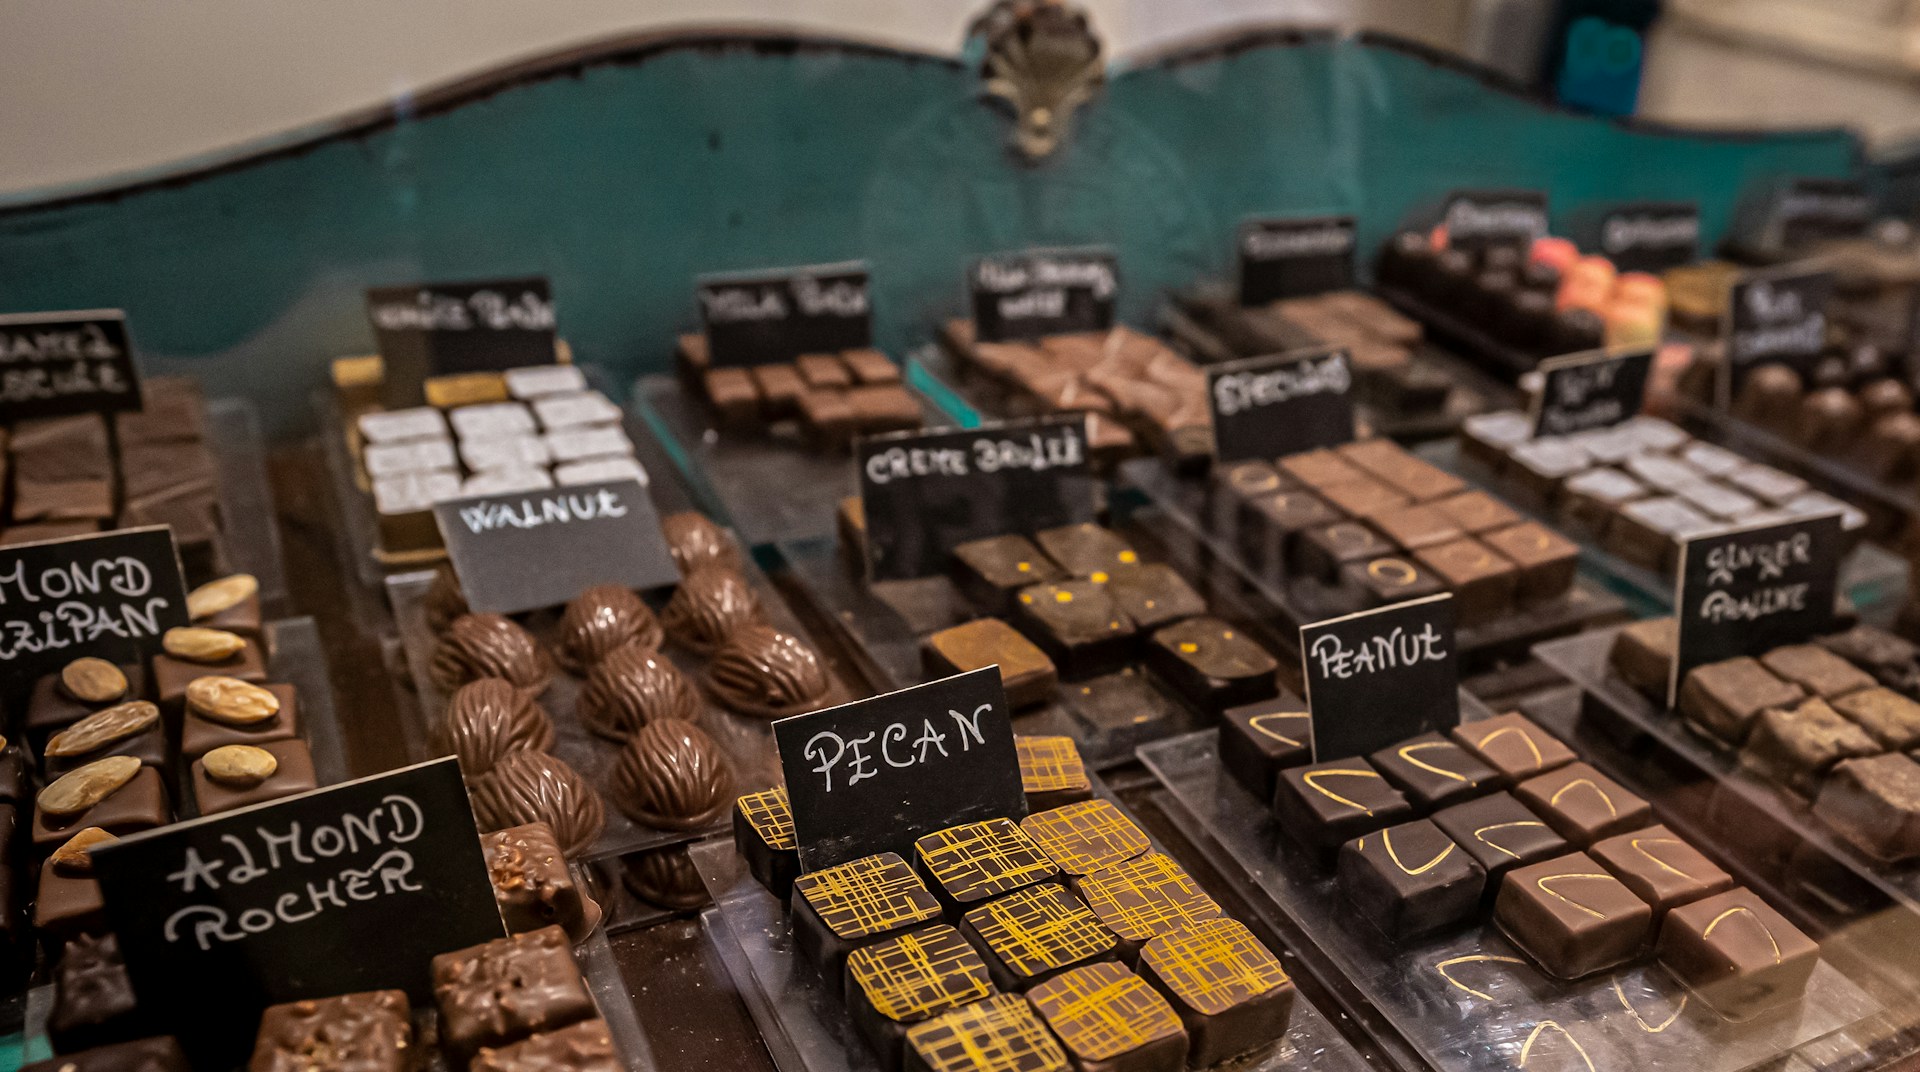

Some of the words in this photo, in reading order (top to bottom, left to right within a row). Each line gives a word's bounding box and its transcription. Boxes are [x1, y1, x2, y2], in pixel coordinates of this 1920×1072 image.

[803, 703, 992, 793] PECAN
[166, 795, 424, 893] ALMOND
[163, 849, 423, 951] ROCHER
